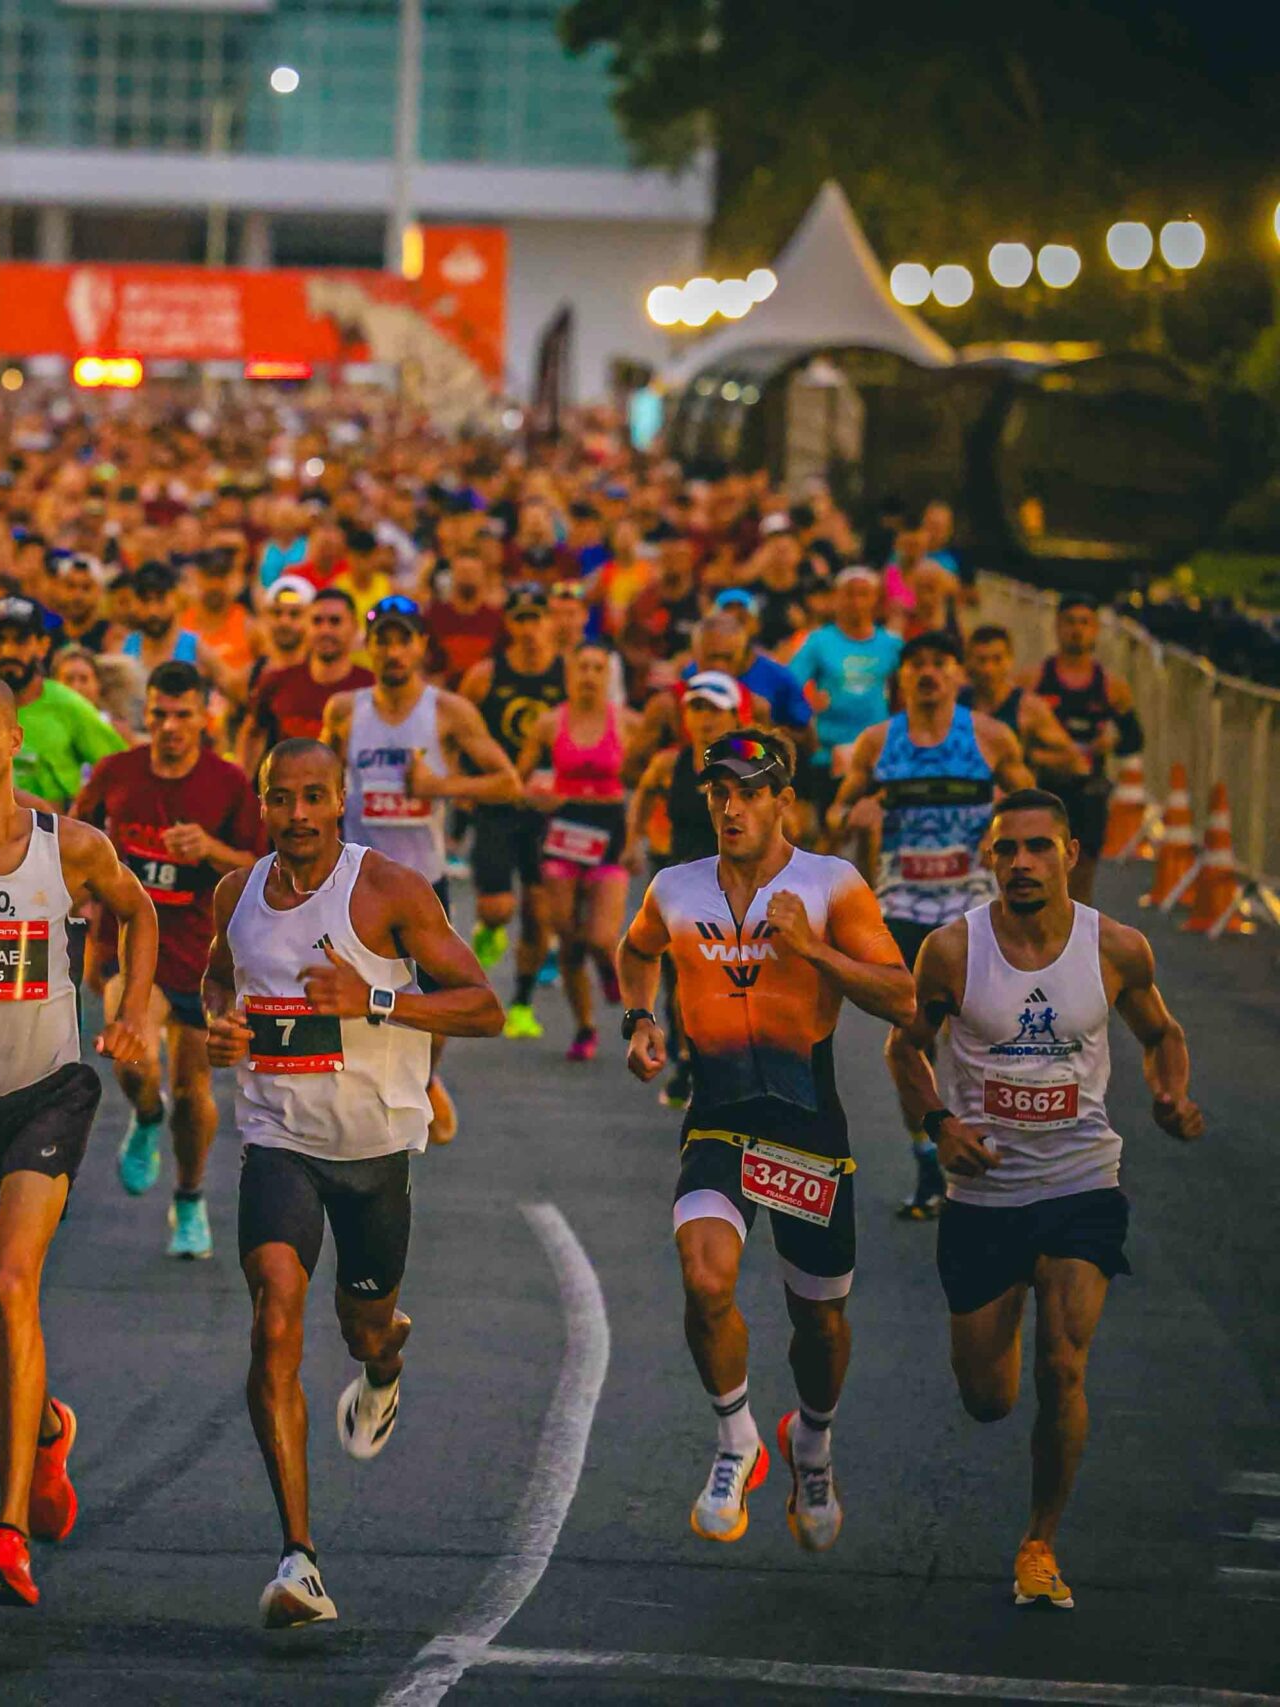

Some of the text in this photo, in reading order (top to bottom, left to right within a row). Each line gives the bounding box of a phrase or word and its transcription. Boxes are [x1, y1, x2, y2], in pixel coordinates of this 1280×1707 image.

[143, 862, 176, 884] 18
[275, 1018, 296, 1047] 7
[997, 1087, 1066, 1113] 3662
[754, 1163, 821, 1202] 3470
